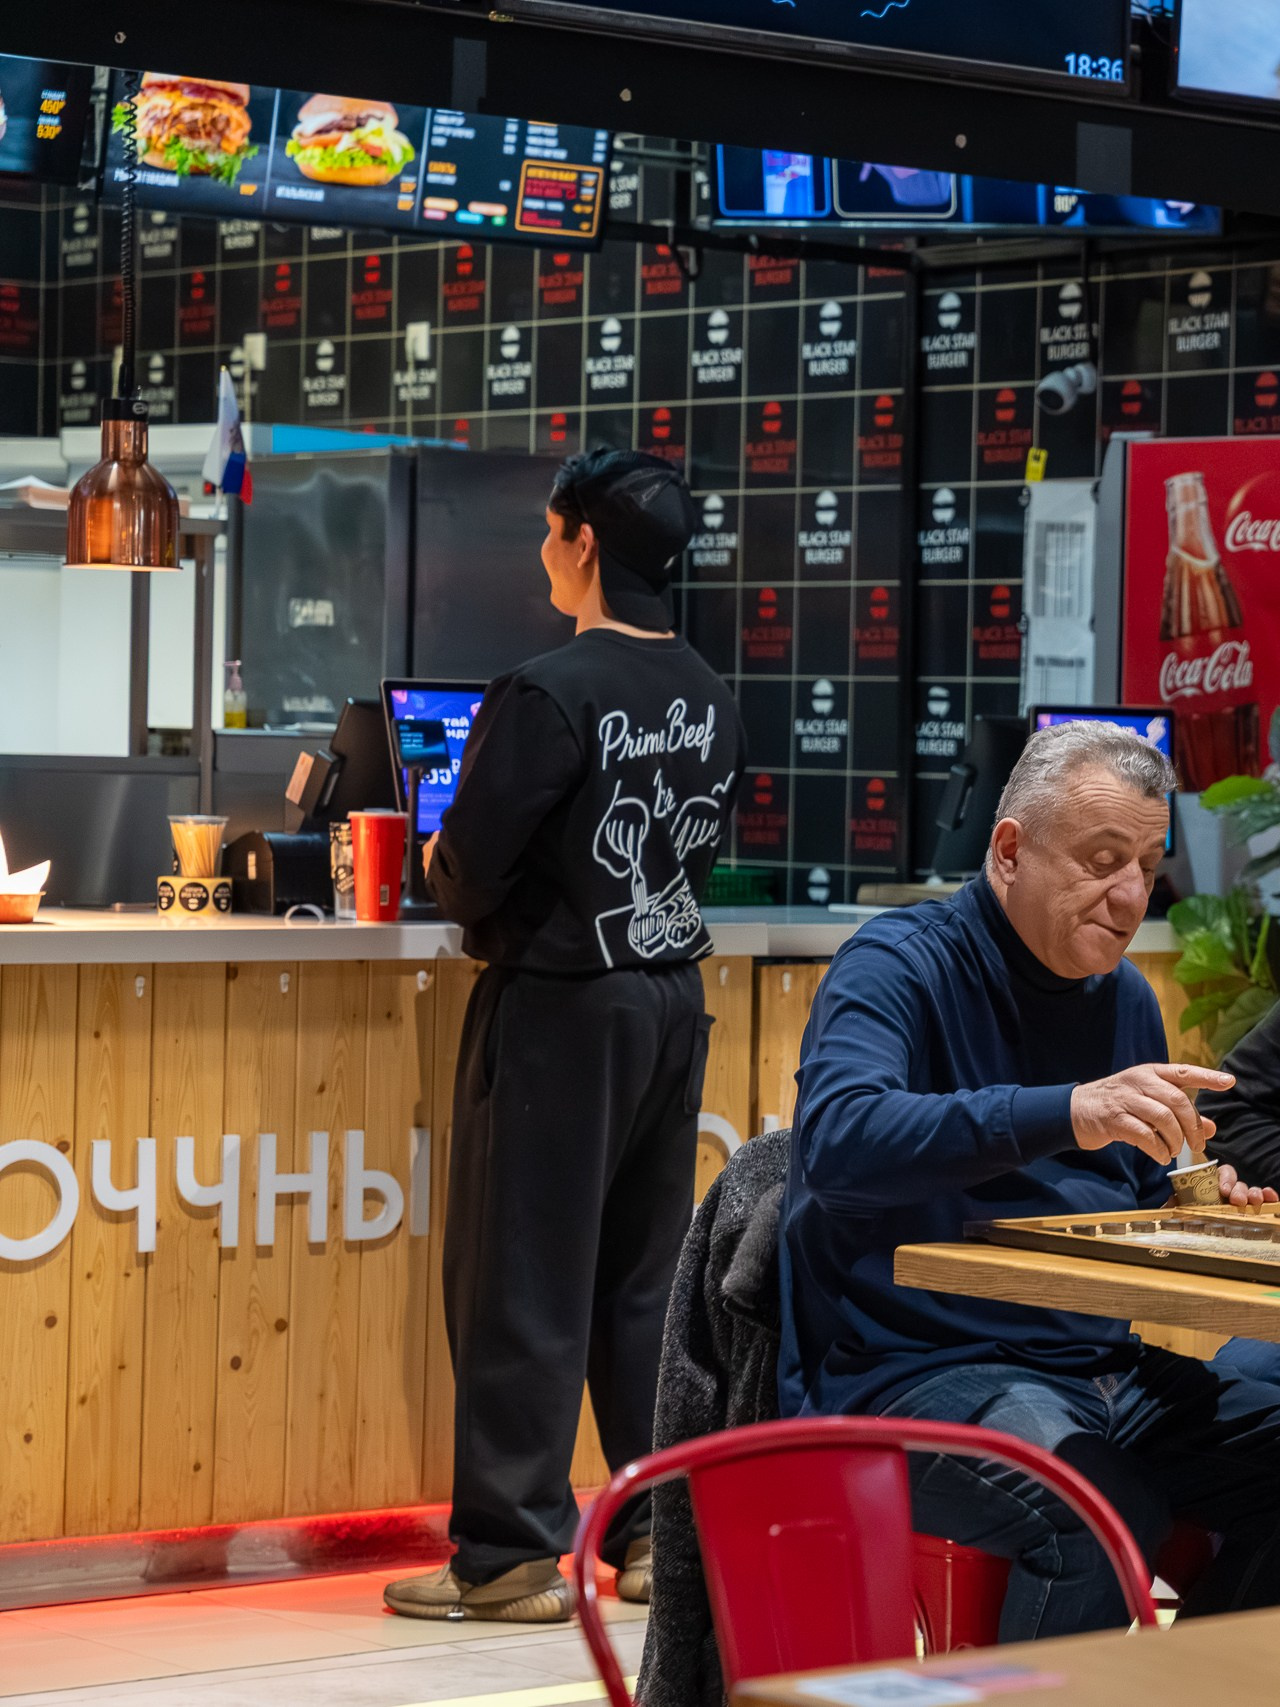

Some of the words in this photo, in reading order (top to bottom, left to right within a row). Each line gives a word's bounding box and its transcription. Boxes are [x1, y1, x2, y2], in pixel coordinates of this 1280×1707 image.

[1064, 52, 1124, 81] 18:36
[1071, 324, 1099, 341] STR
[666, 697, 716, 763] Beef
[915, 722, 942, 739] LACK
